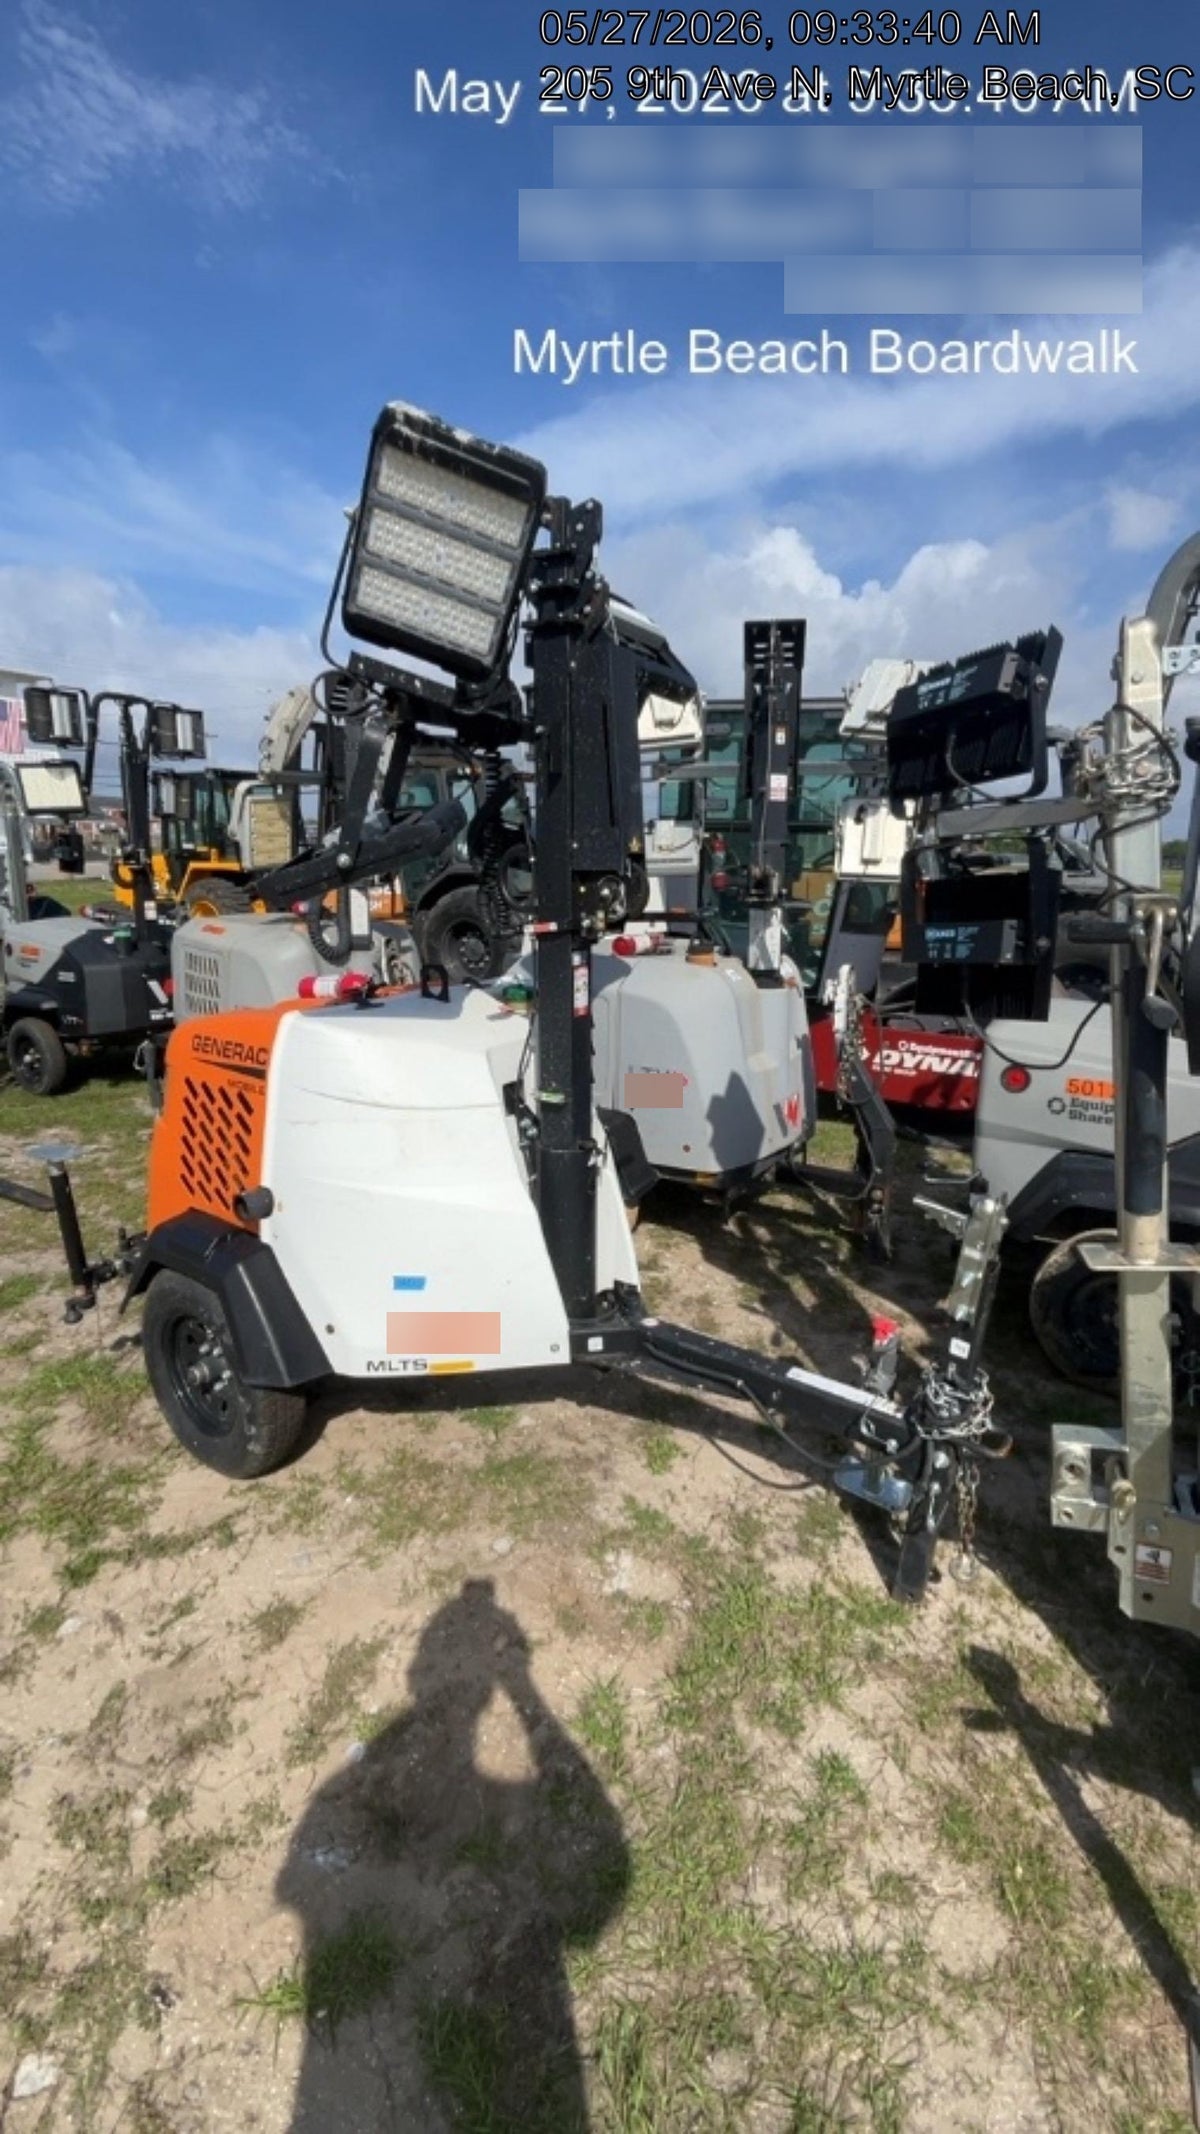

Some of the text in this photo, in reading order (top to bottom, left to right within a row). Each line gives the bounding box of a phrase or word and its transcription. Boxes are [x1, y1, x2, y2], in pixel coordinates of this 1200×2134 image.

[191, 1033, 270, 1067] GENERAC
[872, 1049, 979, 1077] DYNA
[1069, 1109, 1114, 1125] Share
